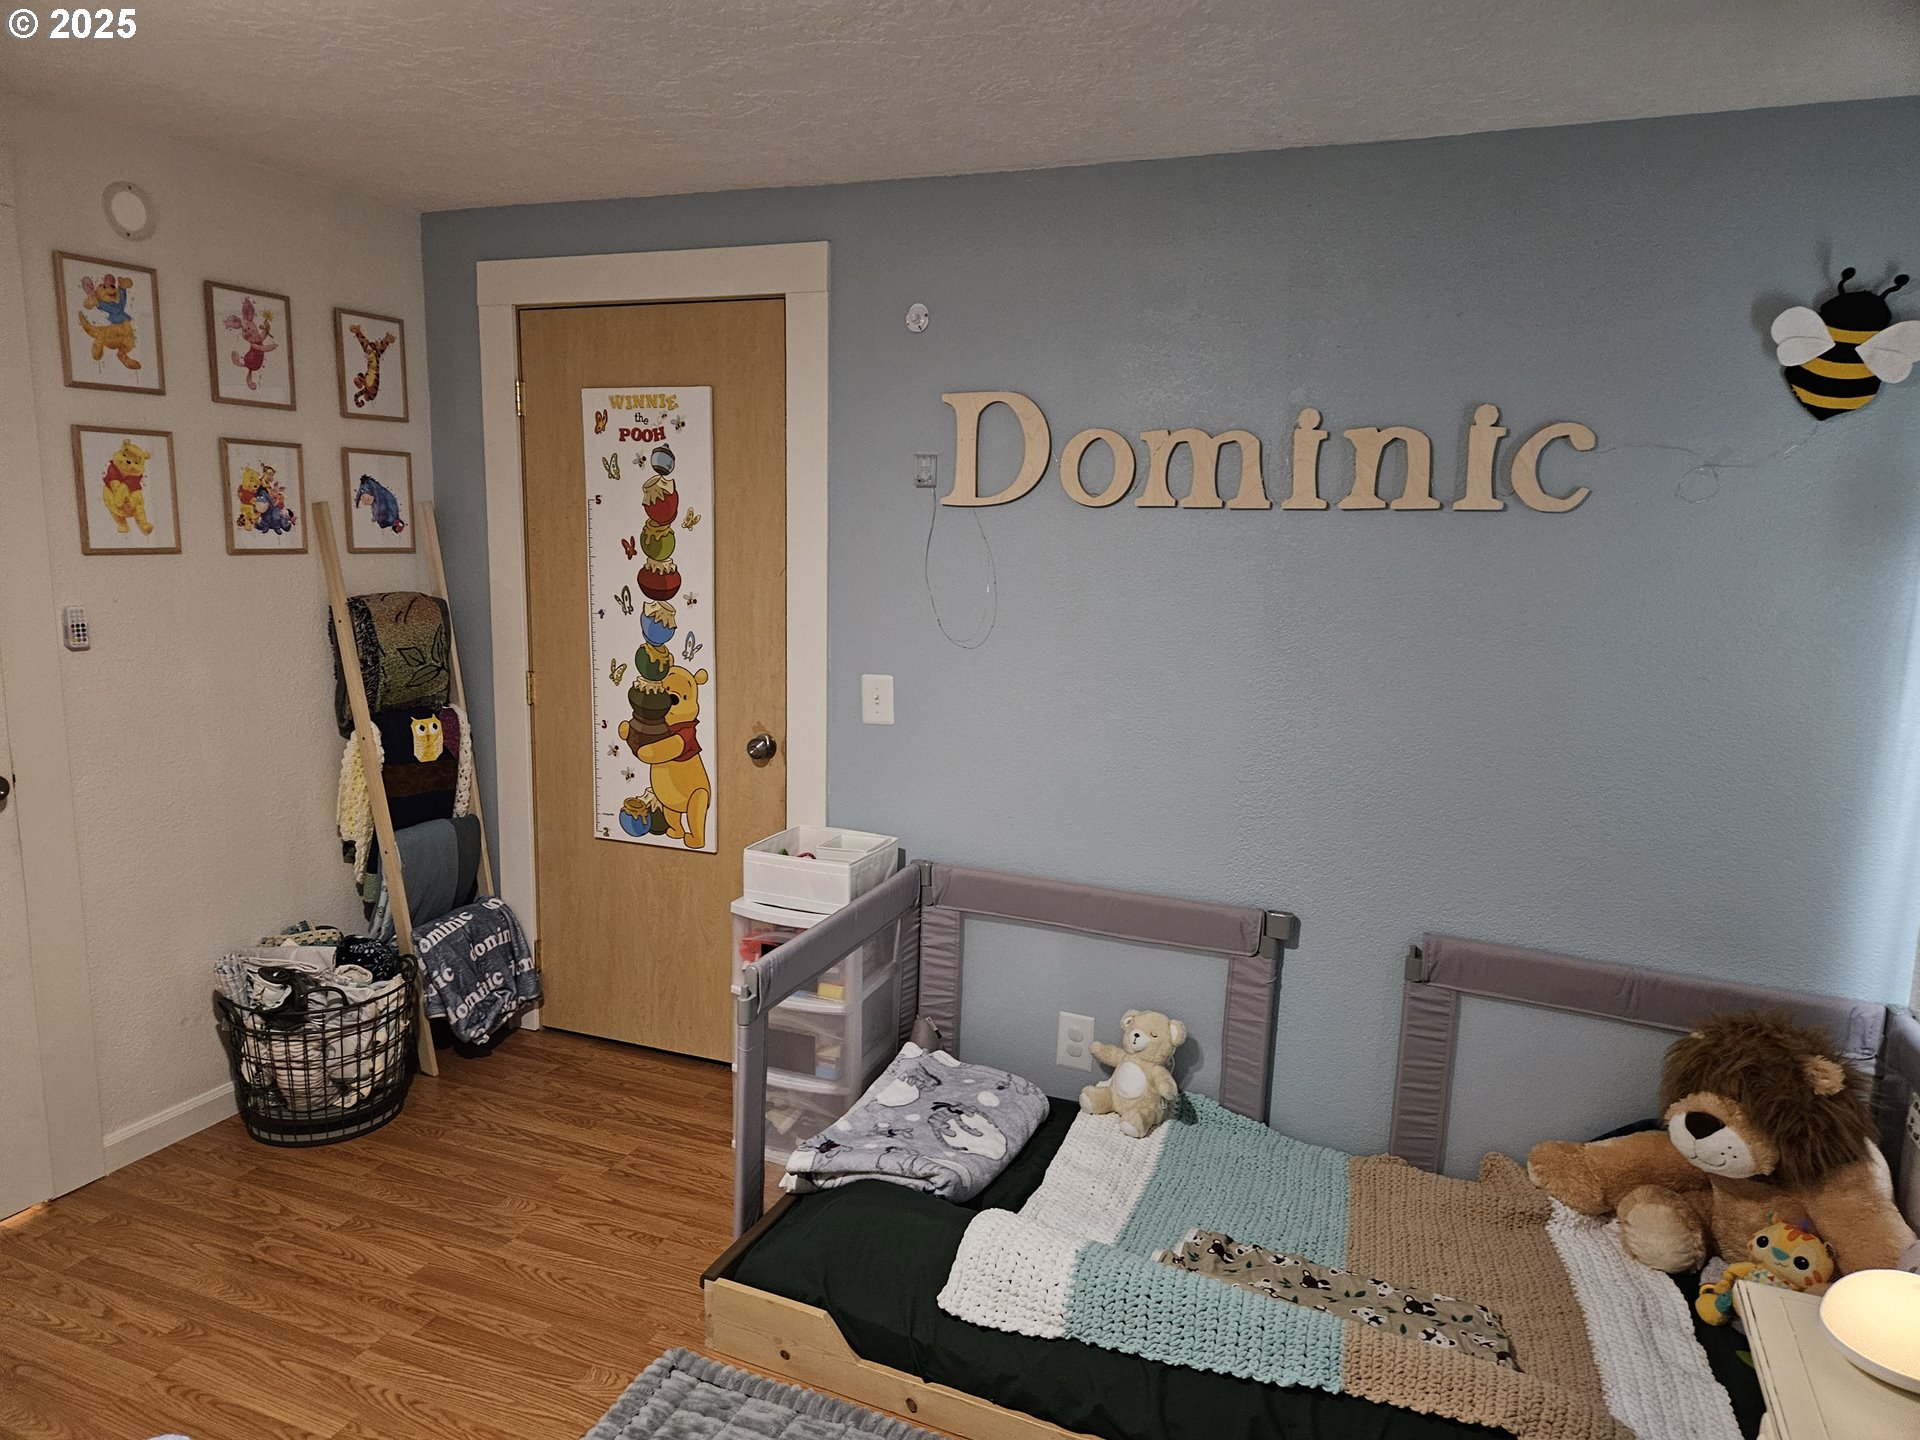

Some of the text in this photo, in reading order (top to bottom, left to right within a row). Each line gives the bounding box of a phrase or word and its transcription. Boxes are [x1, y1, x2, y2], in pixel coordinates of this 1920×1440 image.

[608, 394, 679, 410] WINNIE
[634, 412, 649, 425] the
[618, 426, 667, 442] POOH
[940, 391, 1597, 512] Dominic
[418, 911, 474, 954] ominic
